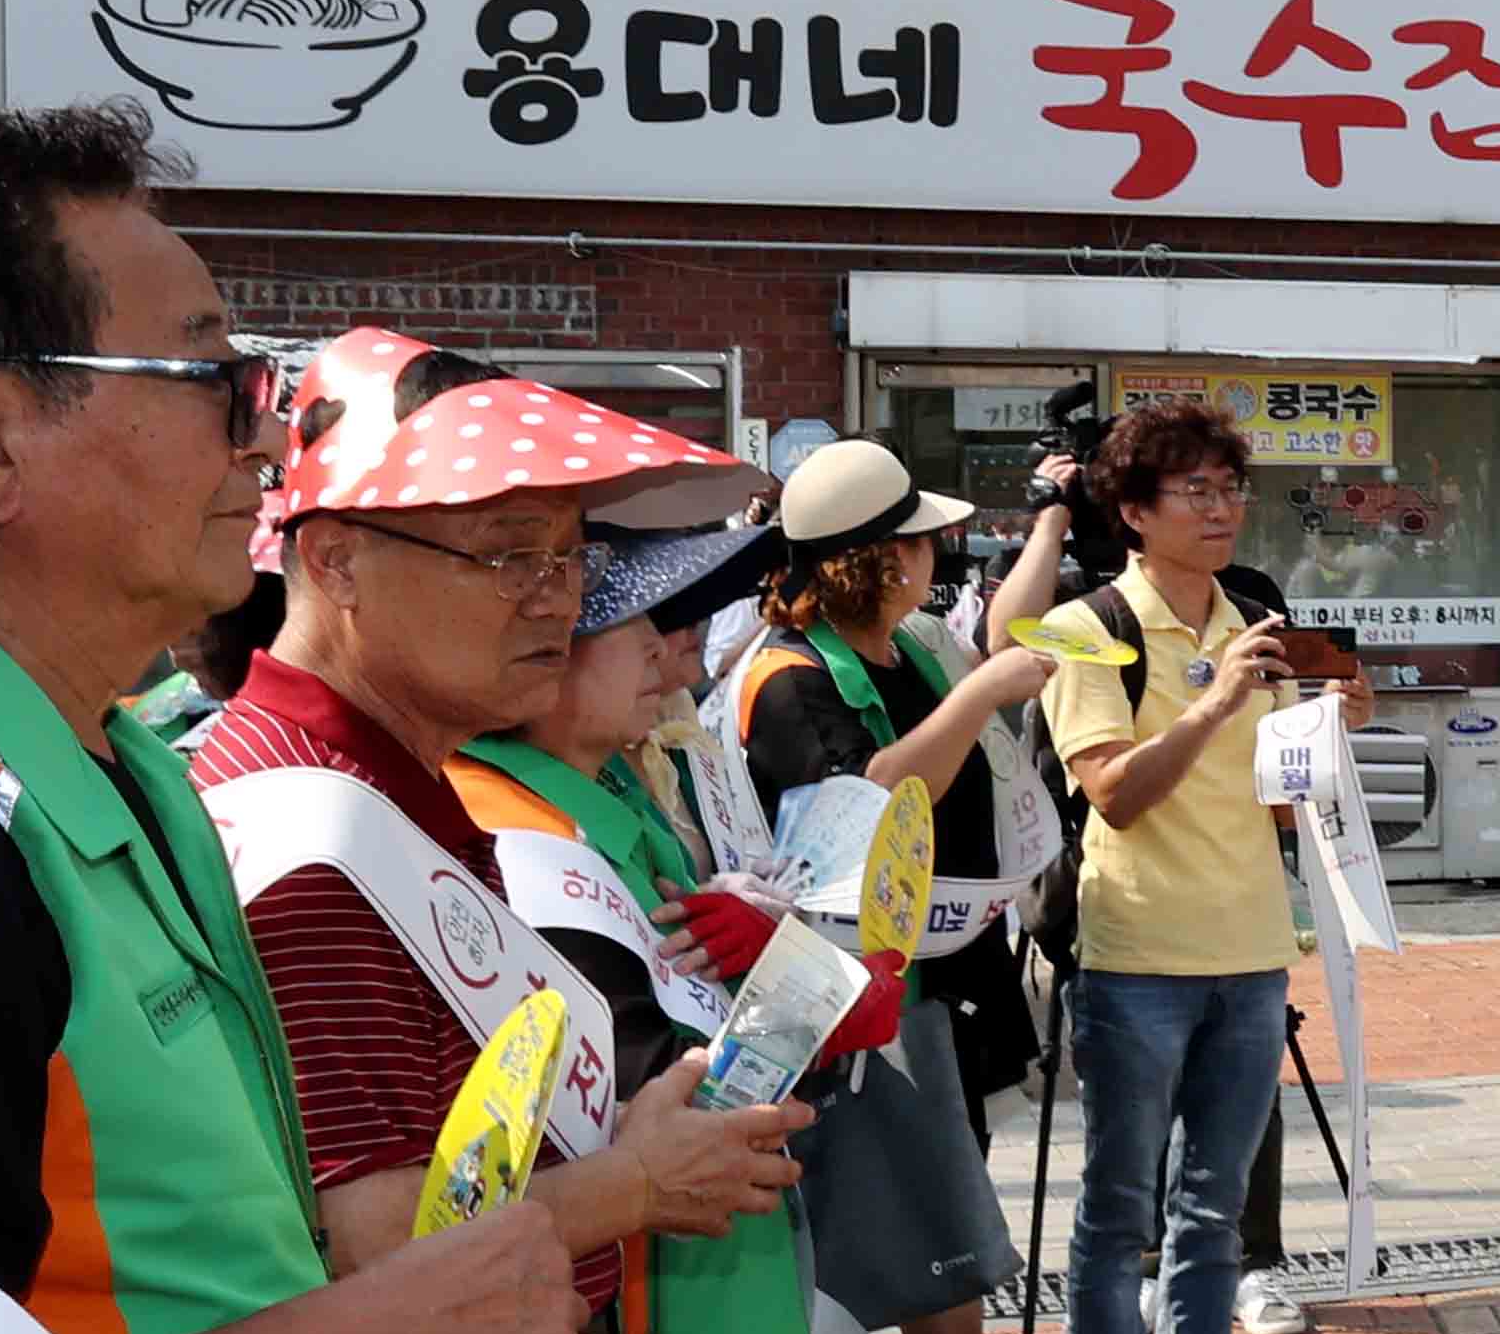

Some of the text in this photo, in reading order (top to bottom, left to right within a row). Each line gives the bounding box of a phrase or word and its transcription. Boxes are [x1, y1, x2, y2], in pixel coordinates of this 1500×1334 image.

[1267, 382, 1380, 422] 콩국수
[1283, 428, 1343, 455] 고소한
[1351, 605, 1384, 626] 부터
[1435, 605, 1496, 627] 8시까지
